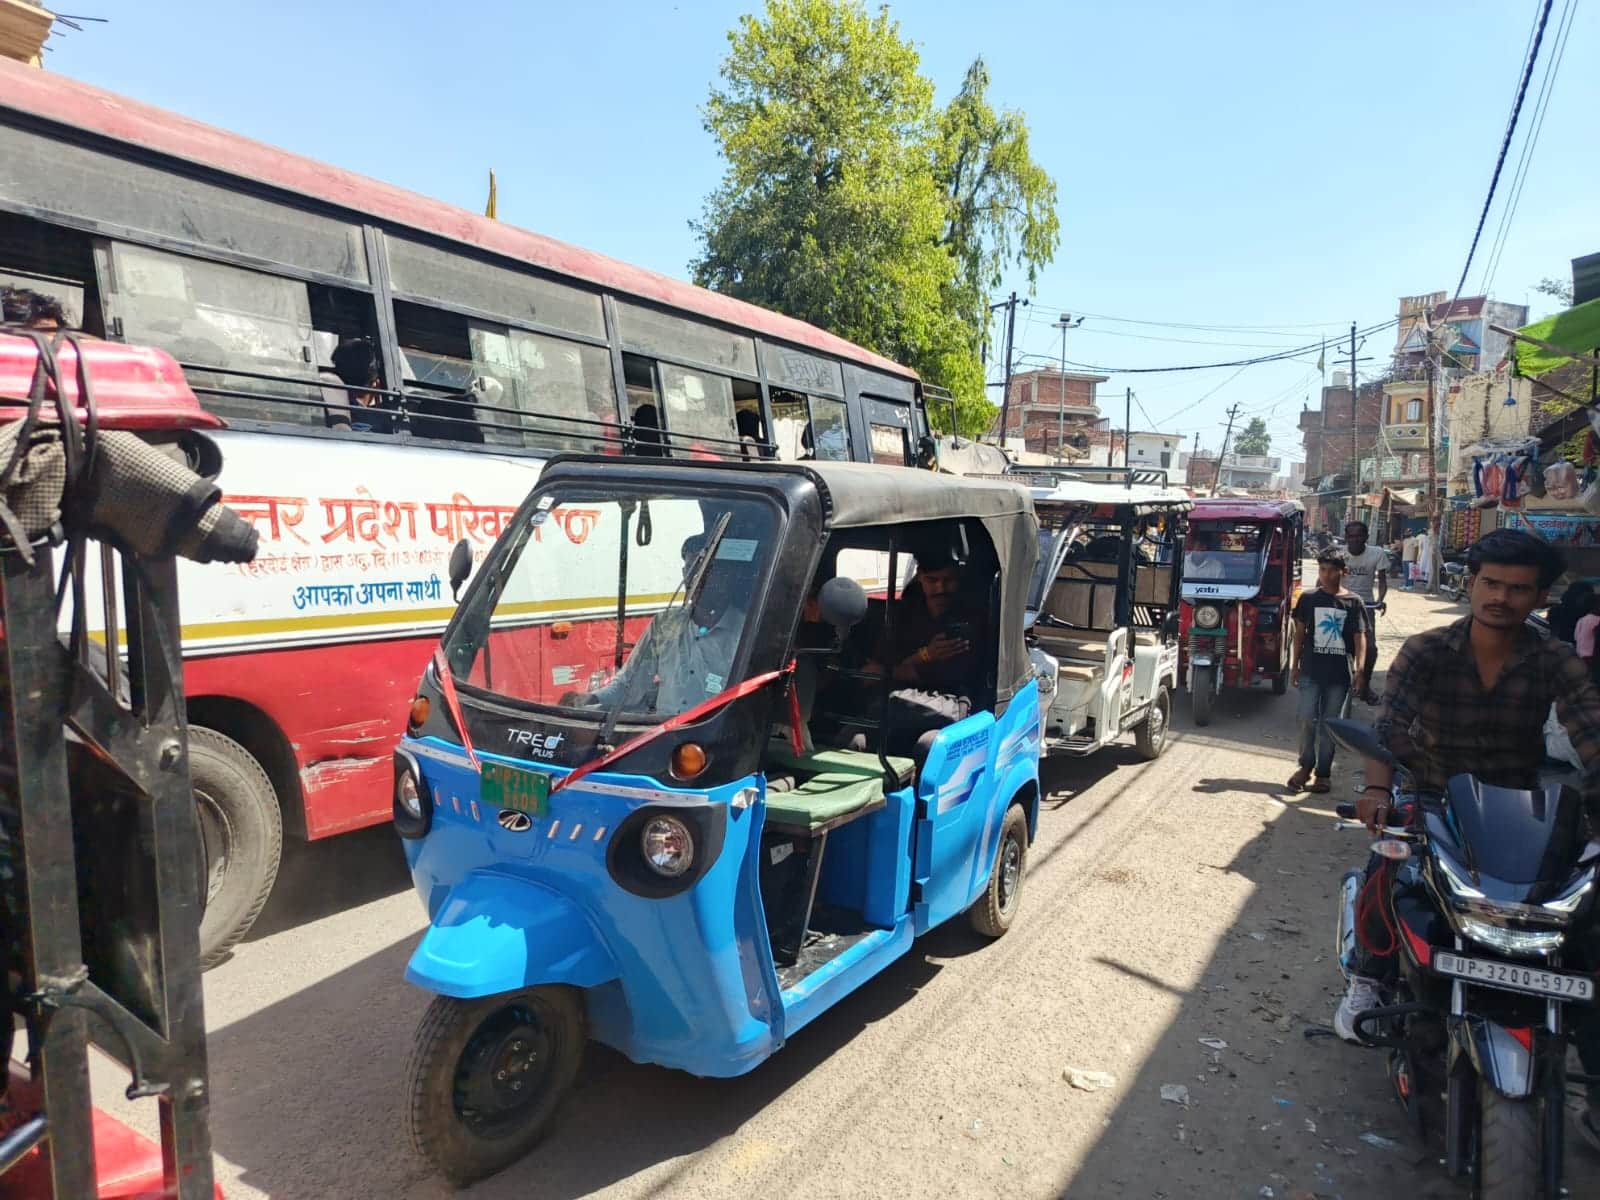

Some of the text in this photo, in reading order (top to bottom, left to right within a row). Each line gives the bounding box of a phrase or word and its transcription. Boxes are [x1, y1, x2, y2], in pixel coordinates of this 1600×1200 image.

[221, 494, 310, 546] त्तर
[318, 484, 419, 550] प्रदेश
[292, 573, 442, 610] आपका अपना साथी
[532, 747, 555, 759] PLUS
